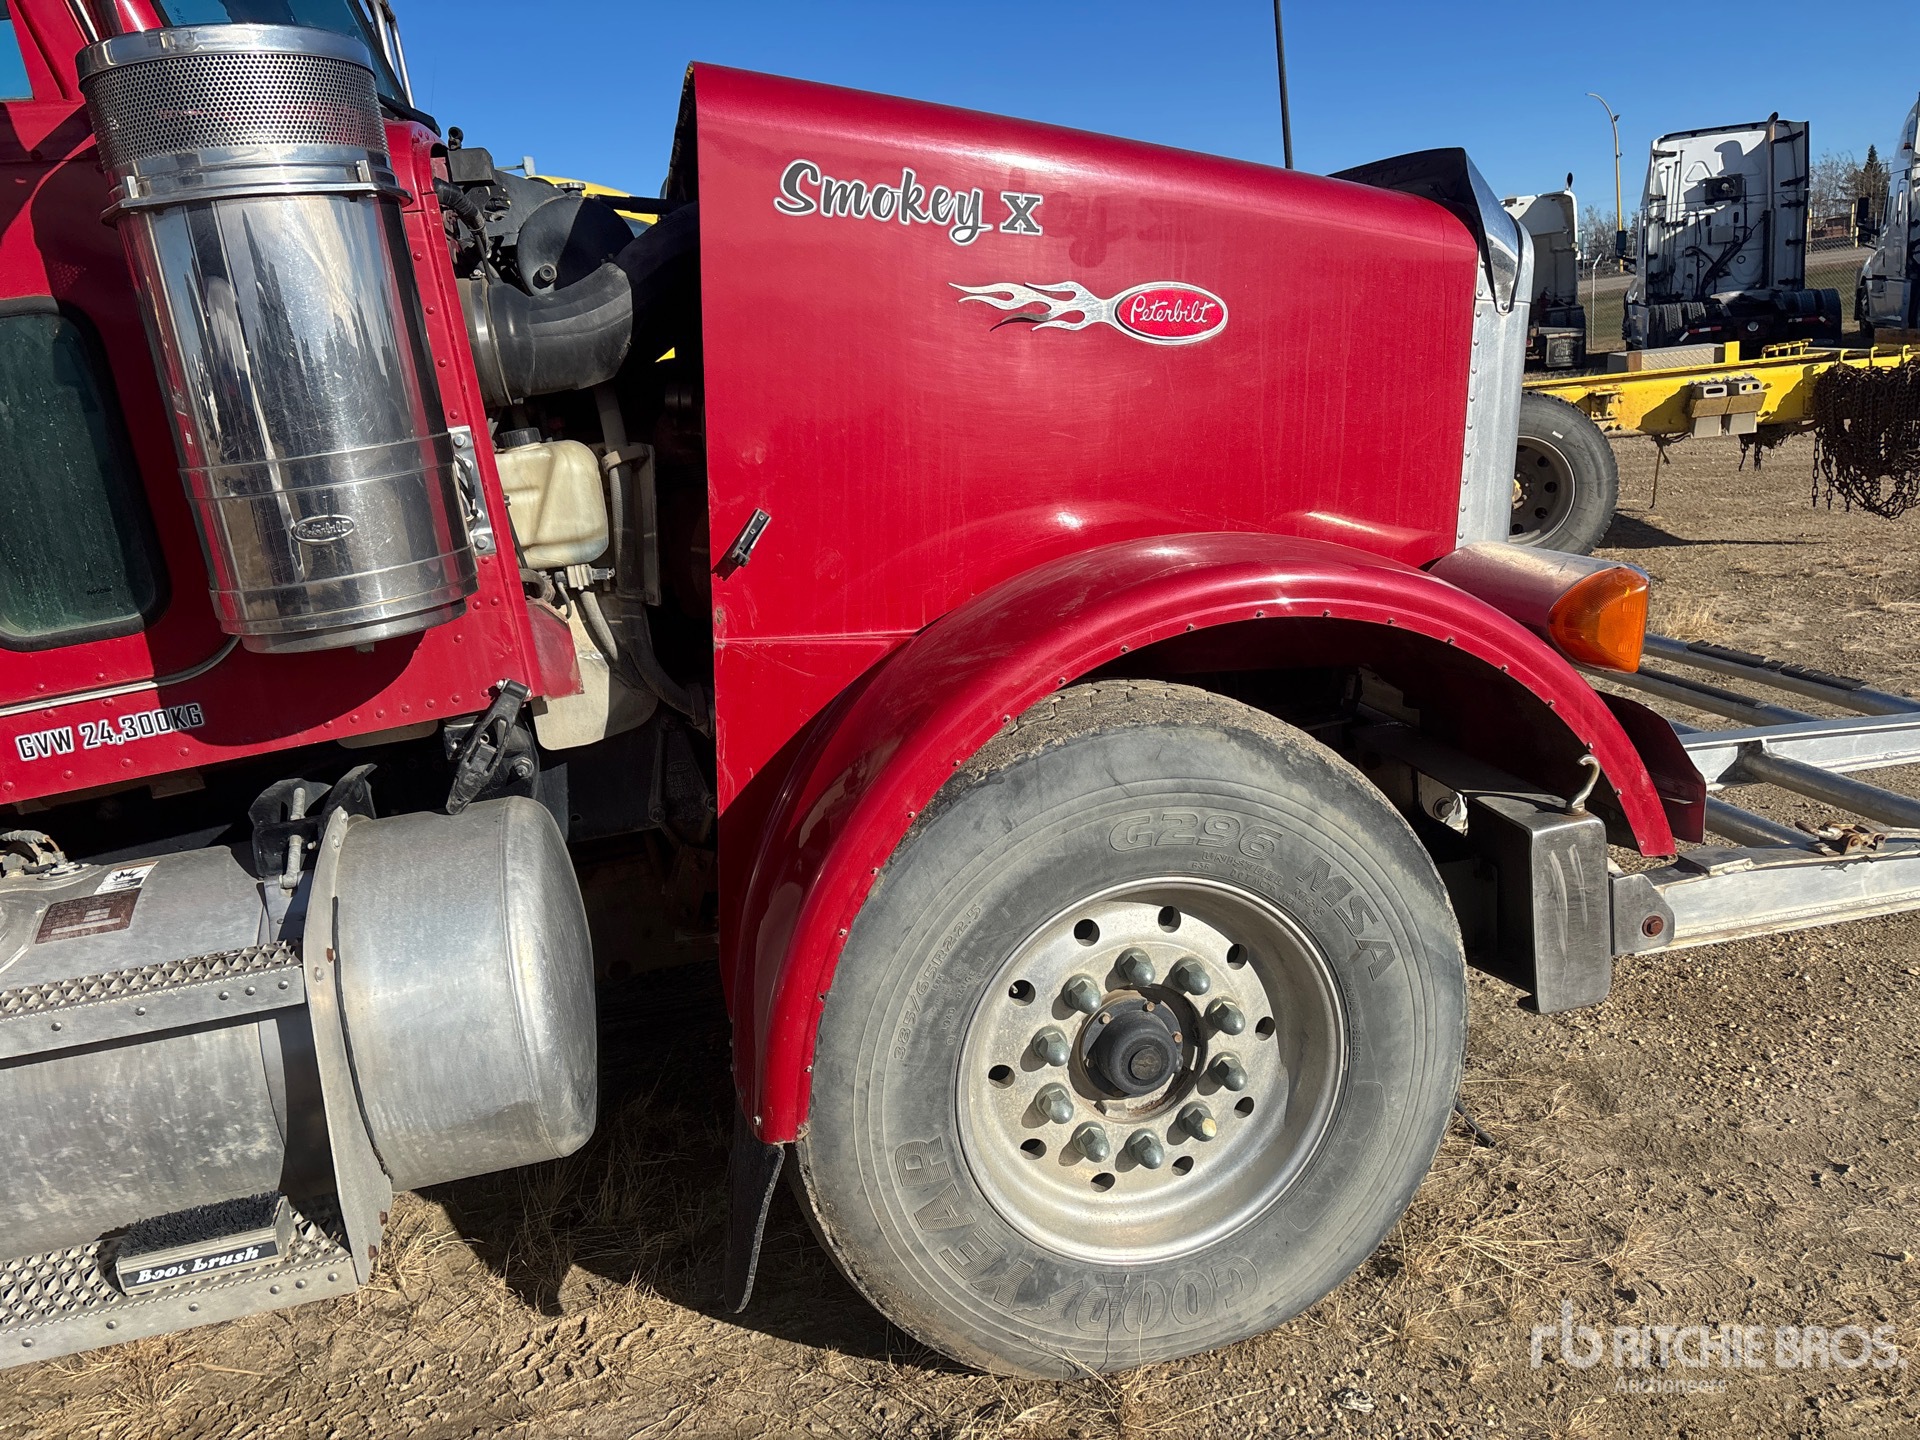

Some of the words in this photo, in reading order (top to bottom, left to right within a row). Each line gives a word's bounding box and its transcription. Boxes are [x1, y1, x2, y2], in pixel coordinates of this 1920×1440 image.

[773, 159, 994, 247] Smokey
[1129, 294, 1216, 325] Peterbilt
[15, 727, 75, 762] GVW
[79, 702, 205, 750] 24,300KG
[1108, 812, 1284, 861] G296
[1295, 856, 1396, 982] MSA
[892, 902, 983, 1061] 385/65R22.5
[136, 1264, 186, 1284] Boot
[190, 1246, 259, 1273] brush
